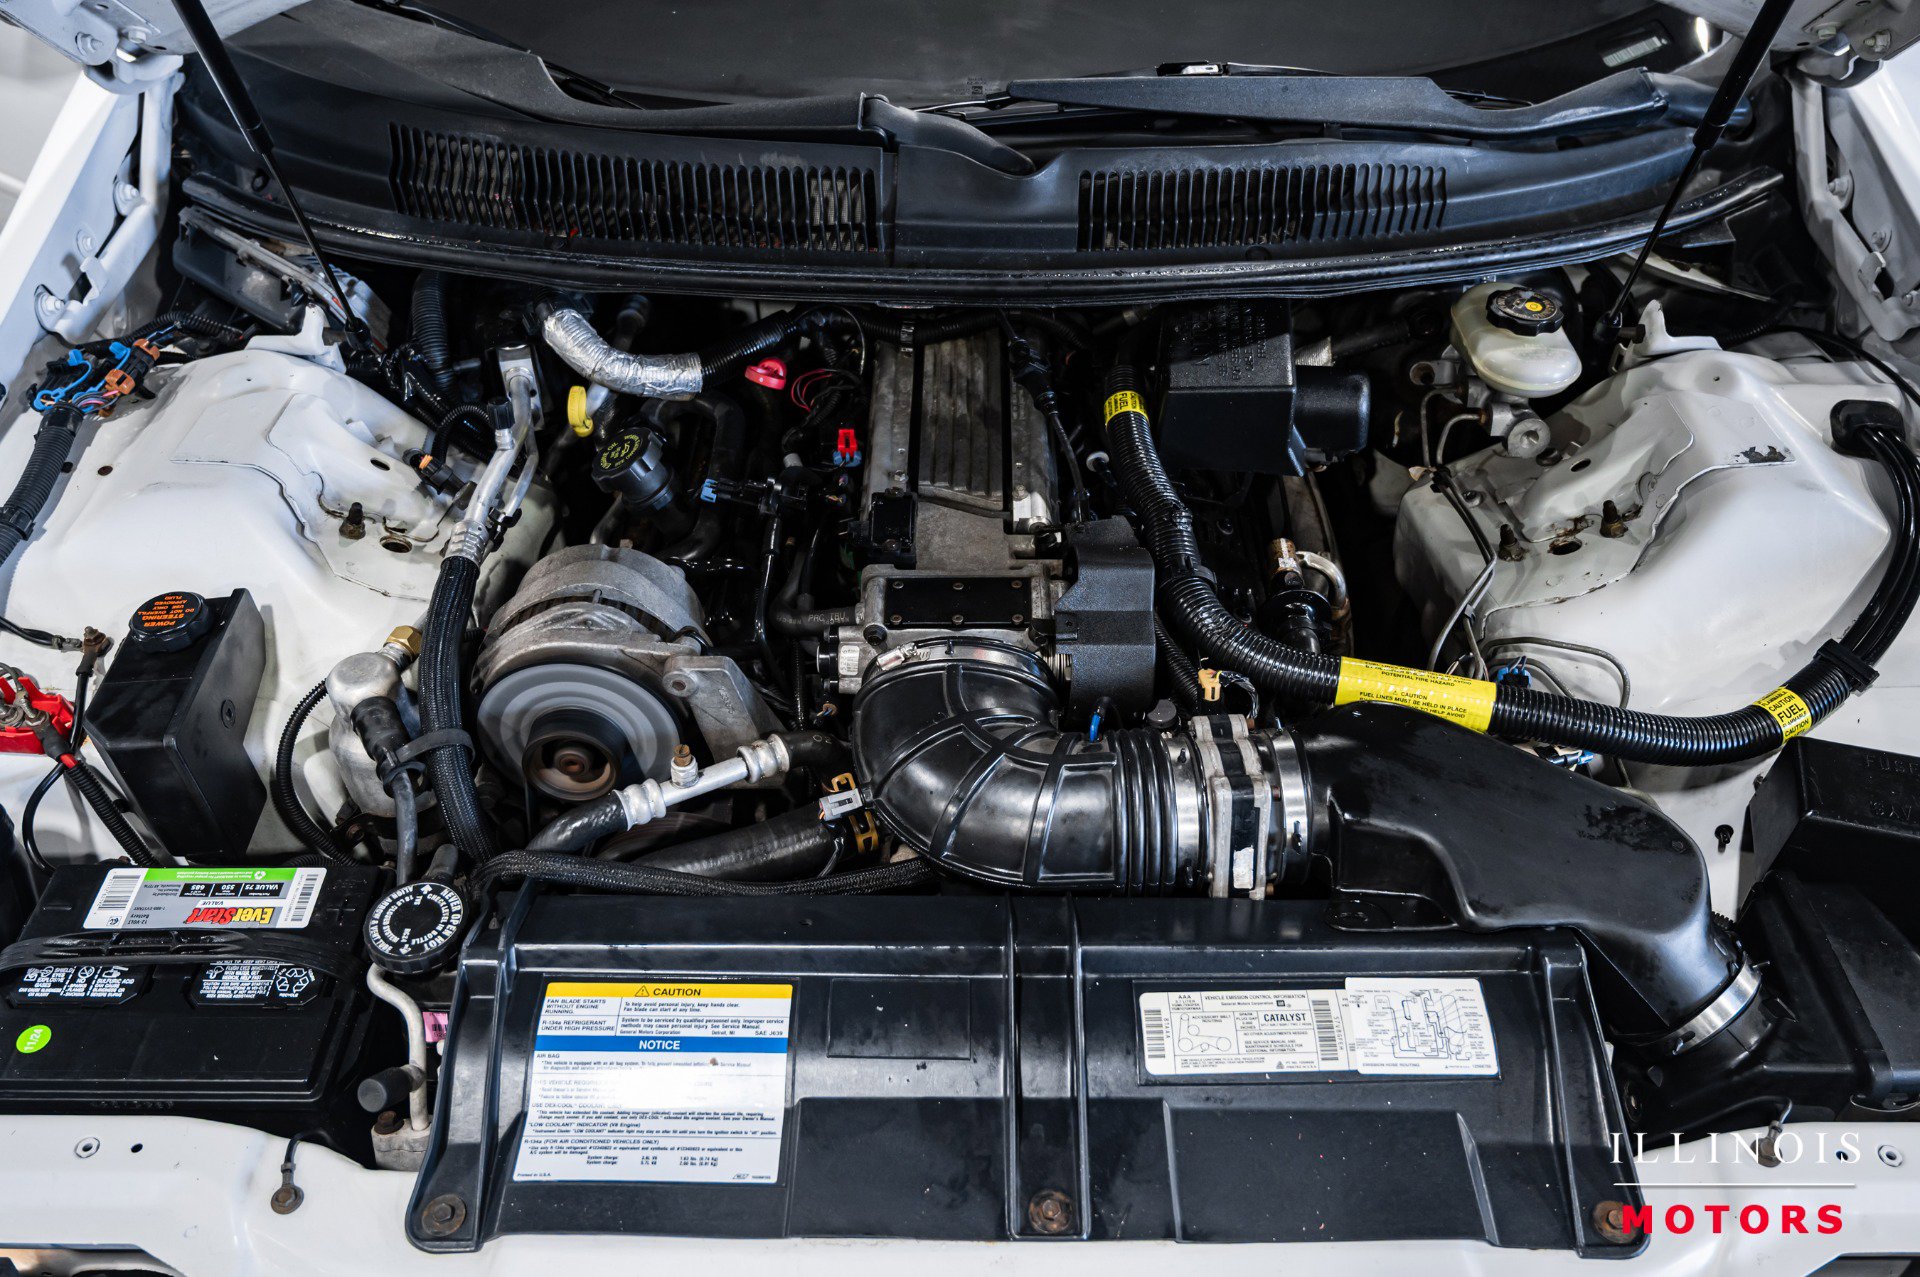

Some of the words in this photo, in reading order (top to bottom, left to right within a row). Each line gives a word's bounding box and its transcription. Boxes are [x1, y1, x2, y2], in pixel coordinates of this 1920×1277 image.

[1119, 393, 1128, 410] FUEL
[608, 442, 618, 450] OIL
[1381, 671, 1414, 680] POTENTIAL
[1401, 691, 1427, 700] CAUTION
[1769, 695, 1796, 712] CAUTION
[1446, 710, 1465, 718] AVOID
[1777, 704, 1804, 722] FUEL
[1785, 718, 1810, 737] CAUTION
[427, 893, 446, 906] CHECK
[441, 888, 461, 912] NEVER
[186, 907, 274, 924] EverStart
[441, 906, 450, 923] LEVEL
[443, 914, 461, 937] OPEN
[411, 930, 438, 945] BOTTLE
[423, 936, 445, 952] HOT
[1264, 1013, 1306, 1022] CATALYST
[639, 1040, 680, 1050] NOTICE
